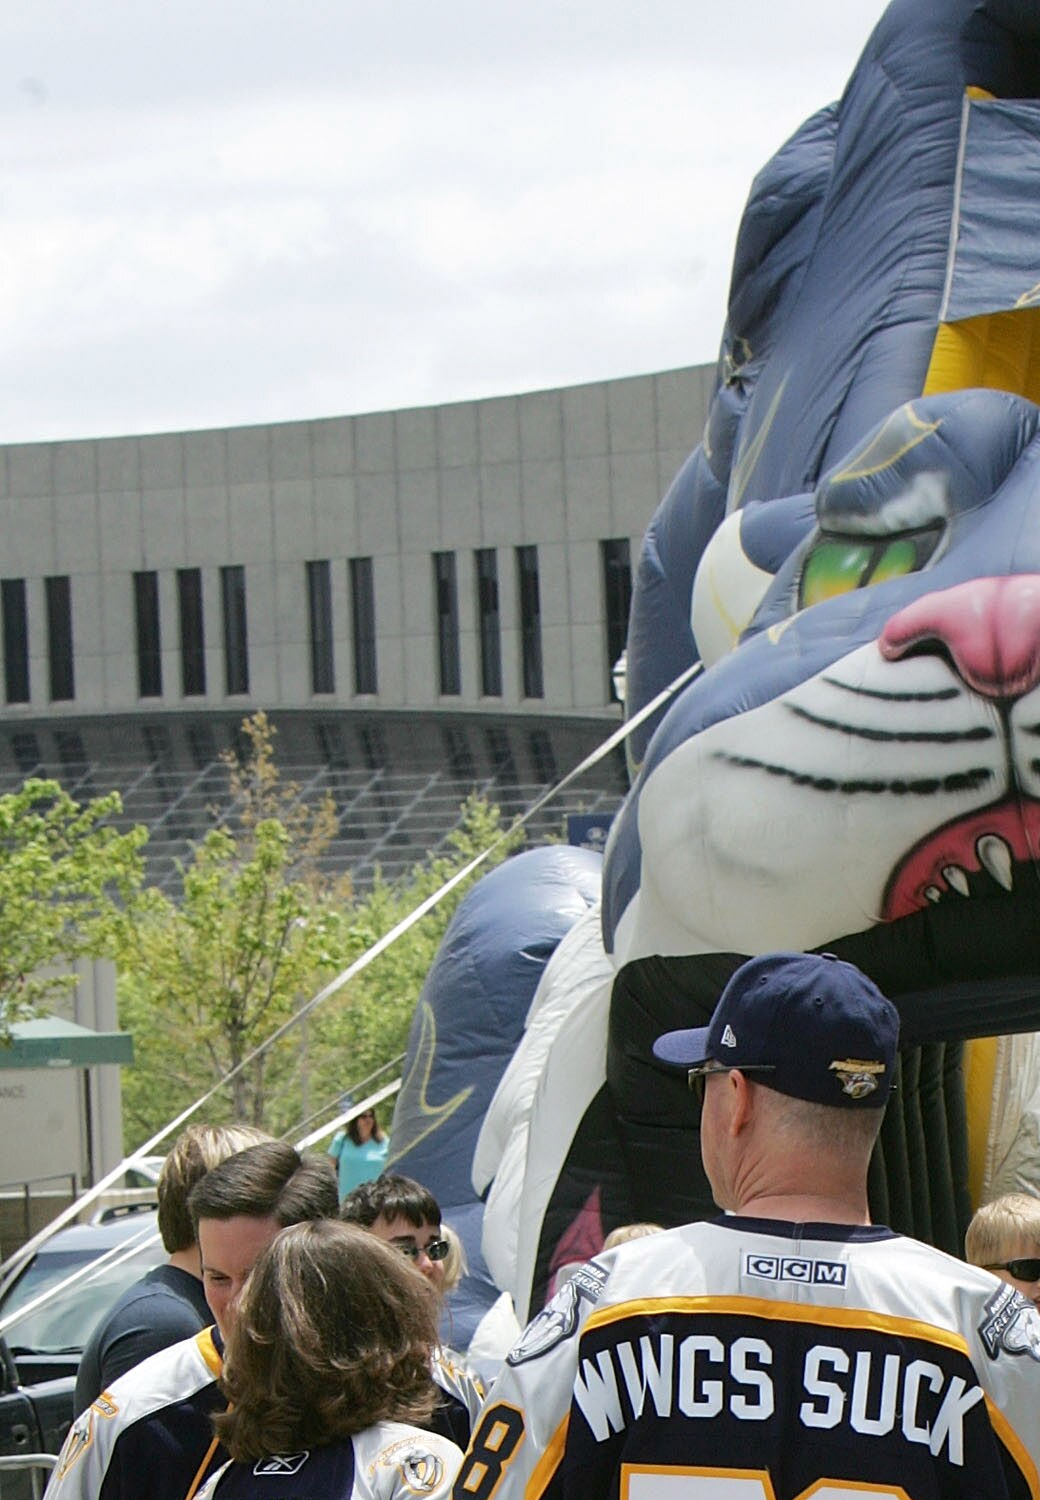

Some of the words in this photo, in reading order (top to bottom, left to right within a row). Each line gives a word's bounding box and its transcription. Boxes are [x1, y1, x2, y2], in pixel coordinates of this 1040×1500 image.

[747, 1255, 846, 1285] CCM
[573, 1333, 775, 1442] WINGS
[799, 1345, 984, 1466] SUCK
